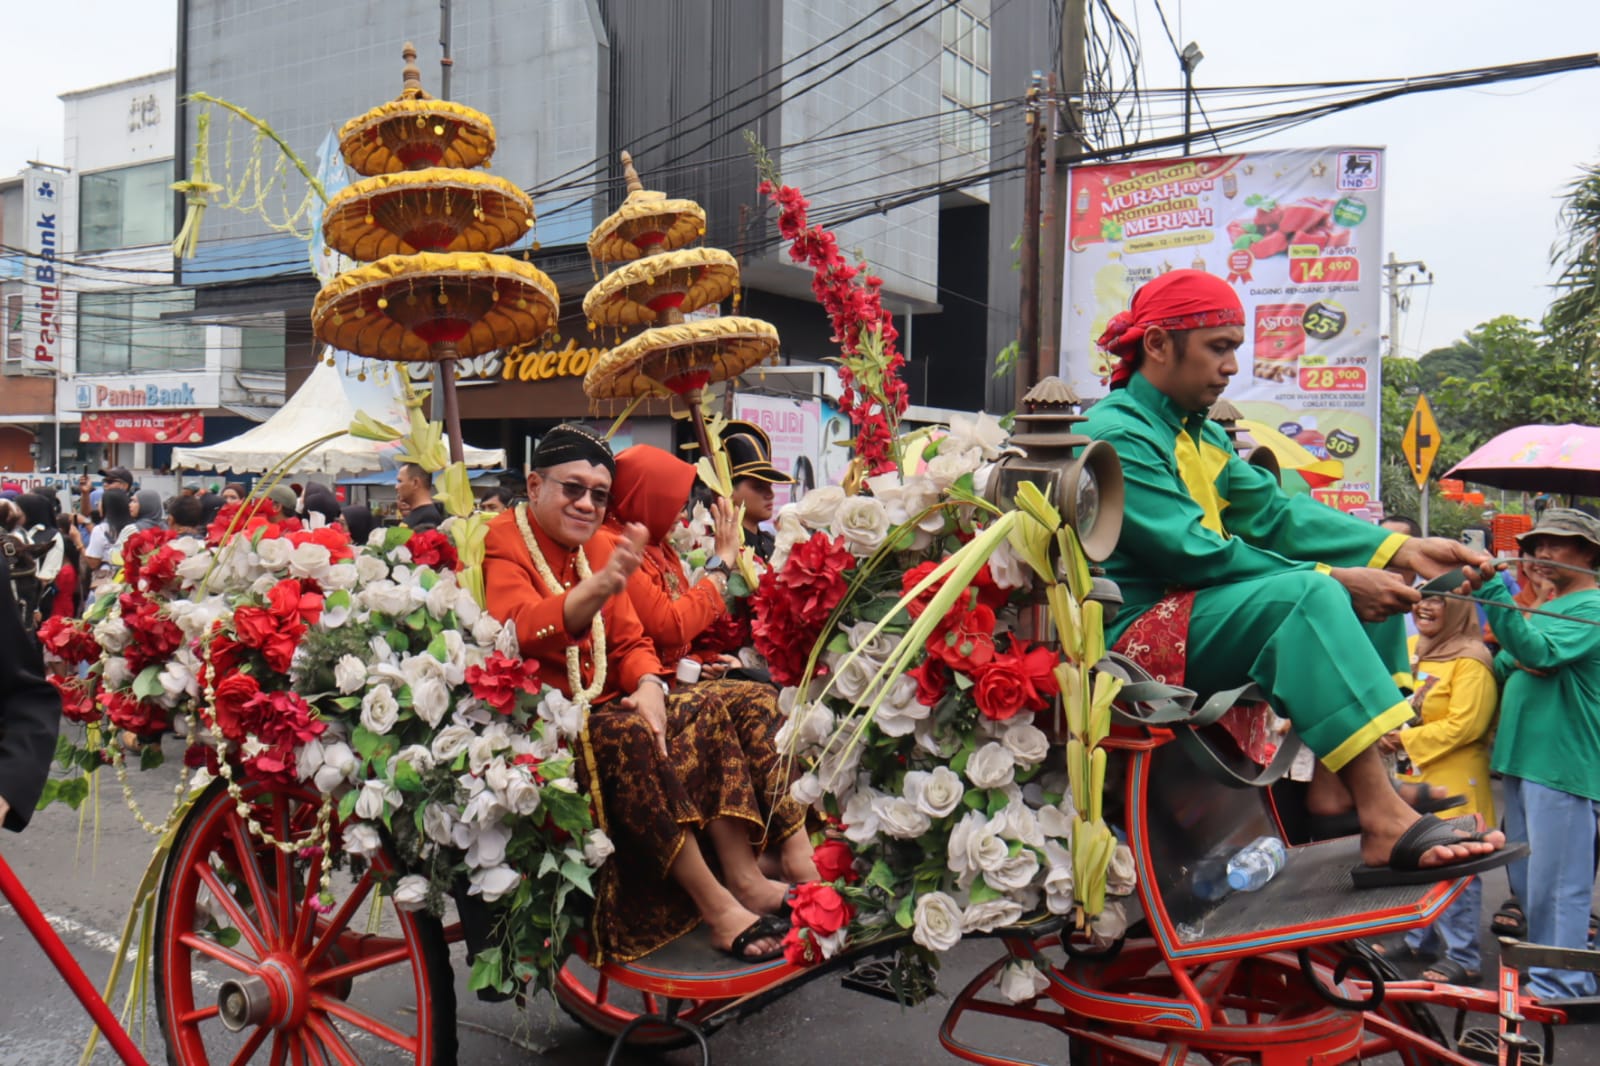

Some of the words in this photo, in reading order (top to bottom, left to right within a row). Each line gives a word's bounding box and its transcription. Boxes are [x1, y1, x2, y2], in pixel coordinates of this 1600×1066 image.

[1111, 164, 1193, 196] Rayakan
[1101, 181, 1182, 214] MURAH
[1182, 179, 1214, 195] nya
[1115, 198, 1194, 222] Ramadan
[1125, 208, 1213, 237] MERIAH
[35, 213, 57, 362] PaninBank
[1304, 313, 1340, 334] 25%
[96, 381, 196, 407] PaninBank
[1327, 437, 1355, 454] 30%
